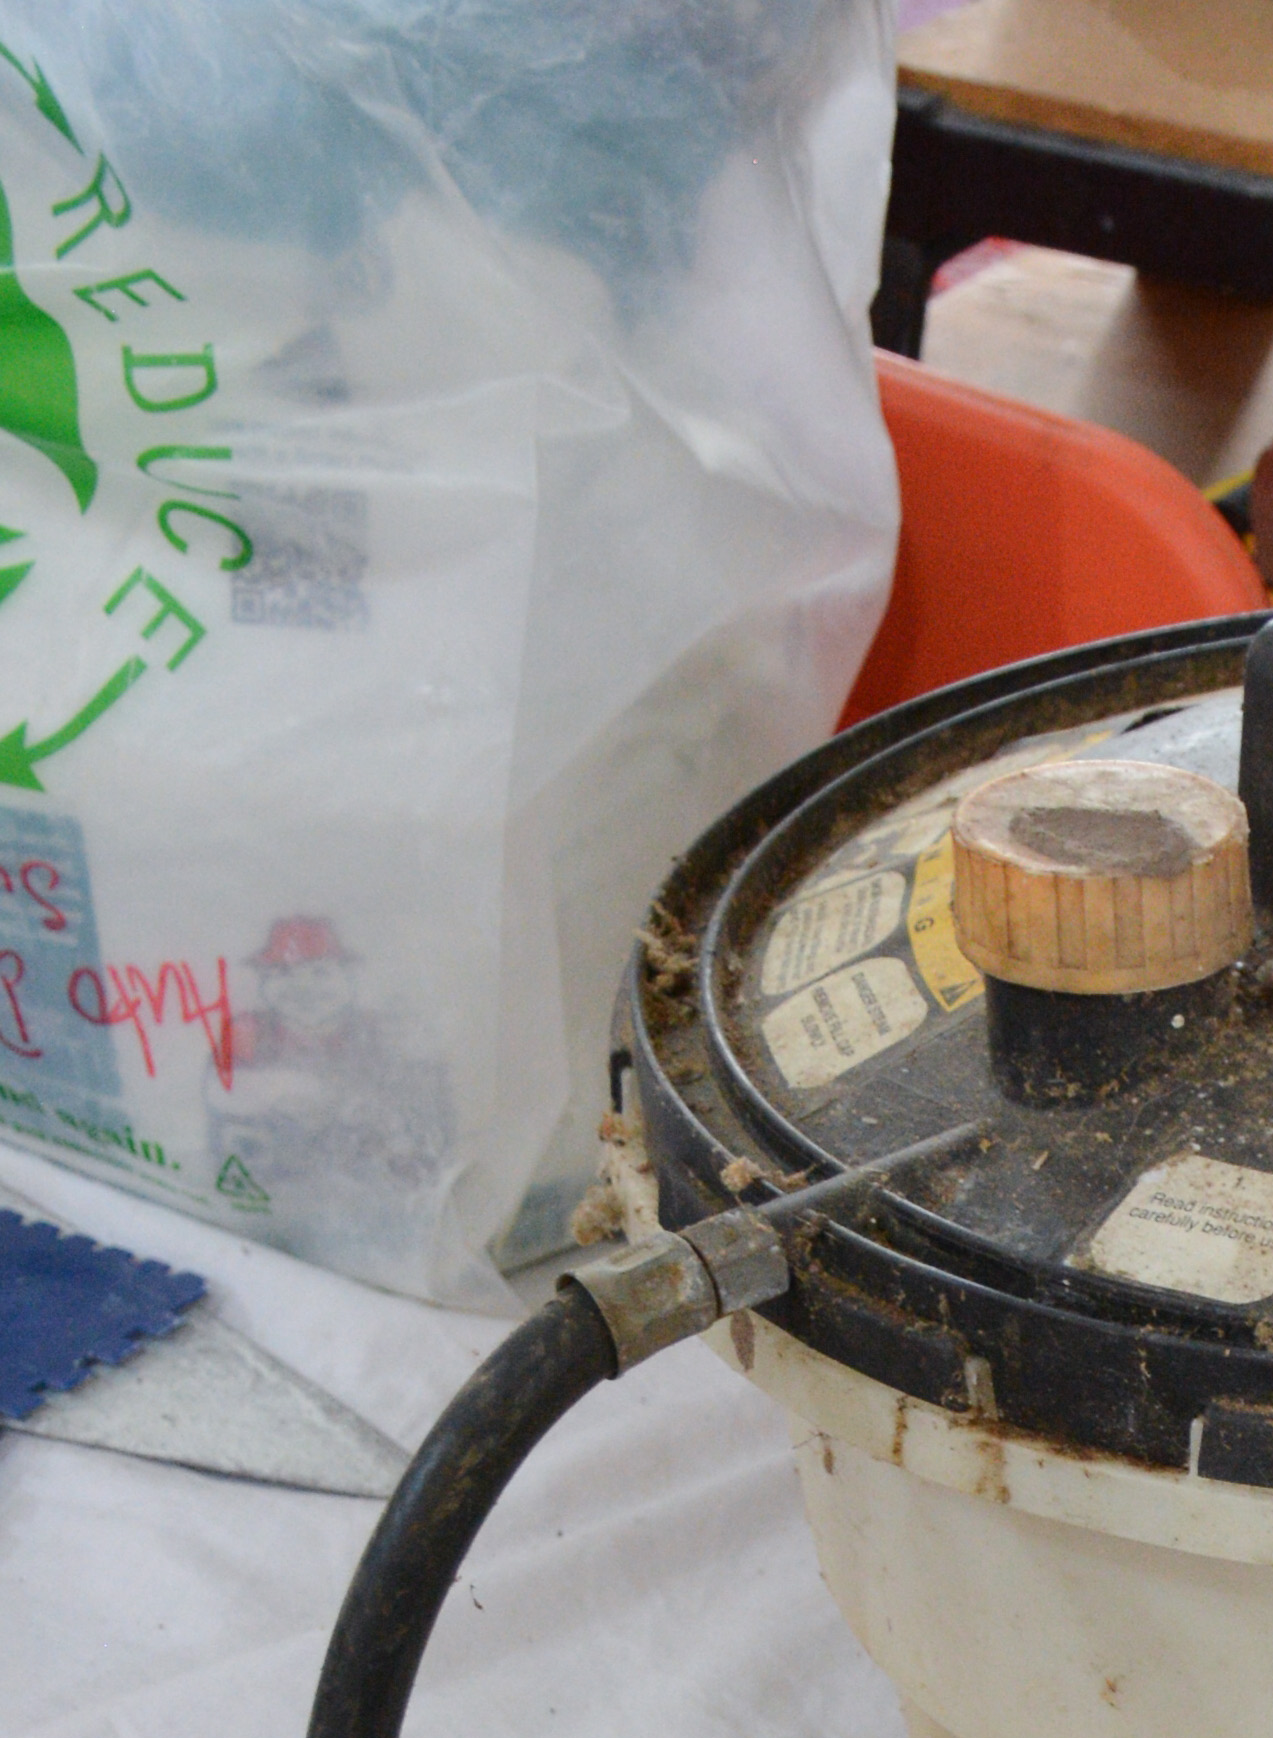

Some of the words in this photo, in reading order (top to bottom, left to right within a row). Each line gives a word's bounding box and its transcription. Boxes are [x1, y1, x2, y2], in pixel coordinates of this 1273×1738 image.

[52, 152, 253, 672] REDUCE
[1151, 1191, 1196, 1211] Read
[1129, 1205, 1200, 1233] carefully
[1202, 1220, 1256, 1243] before
